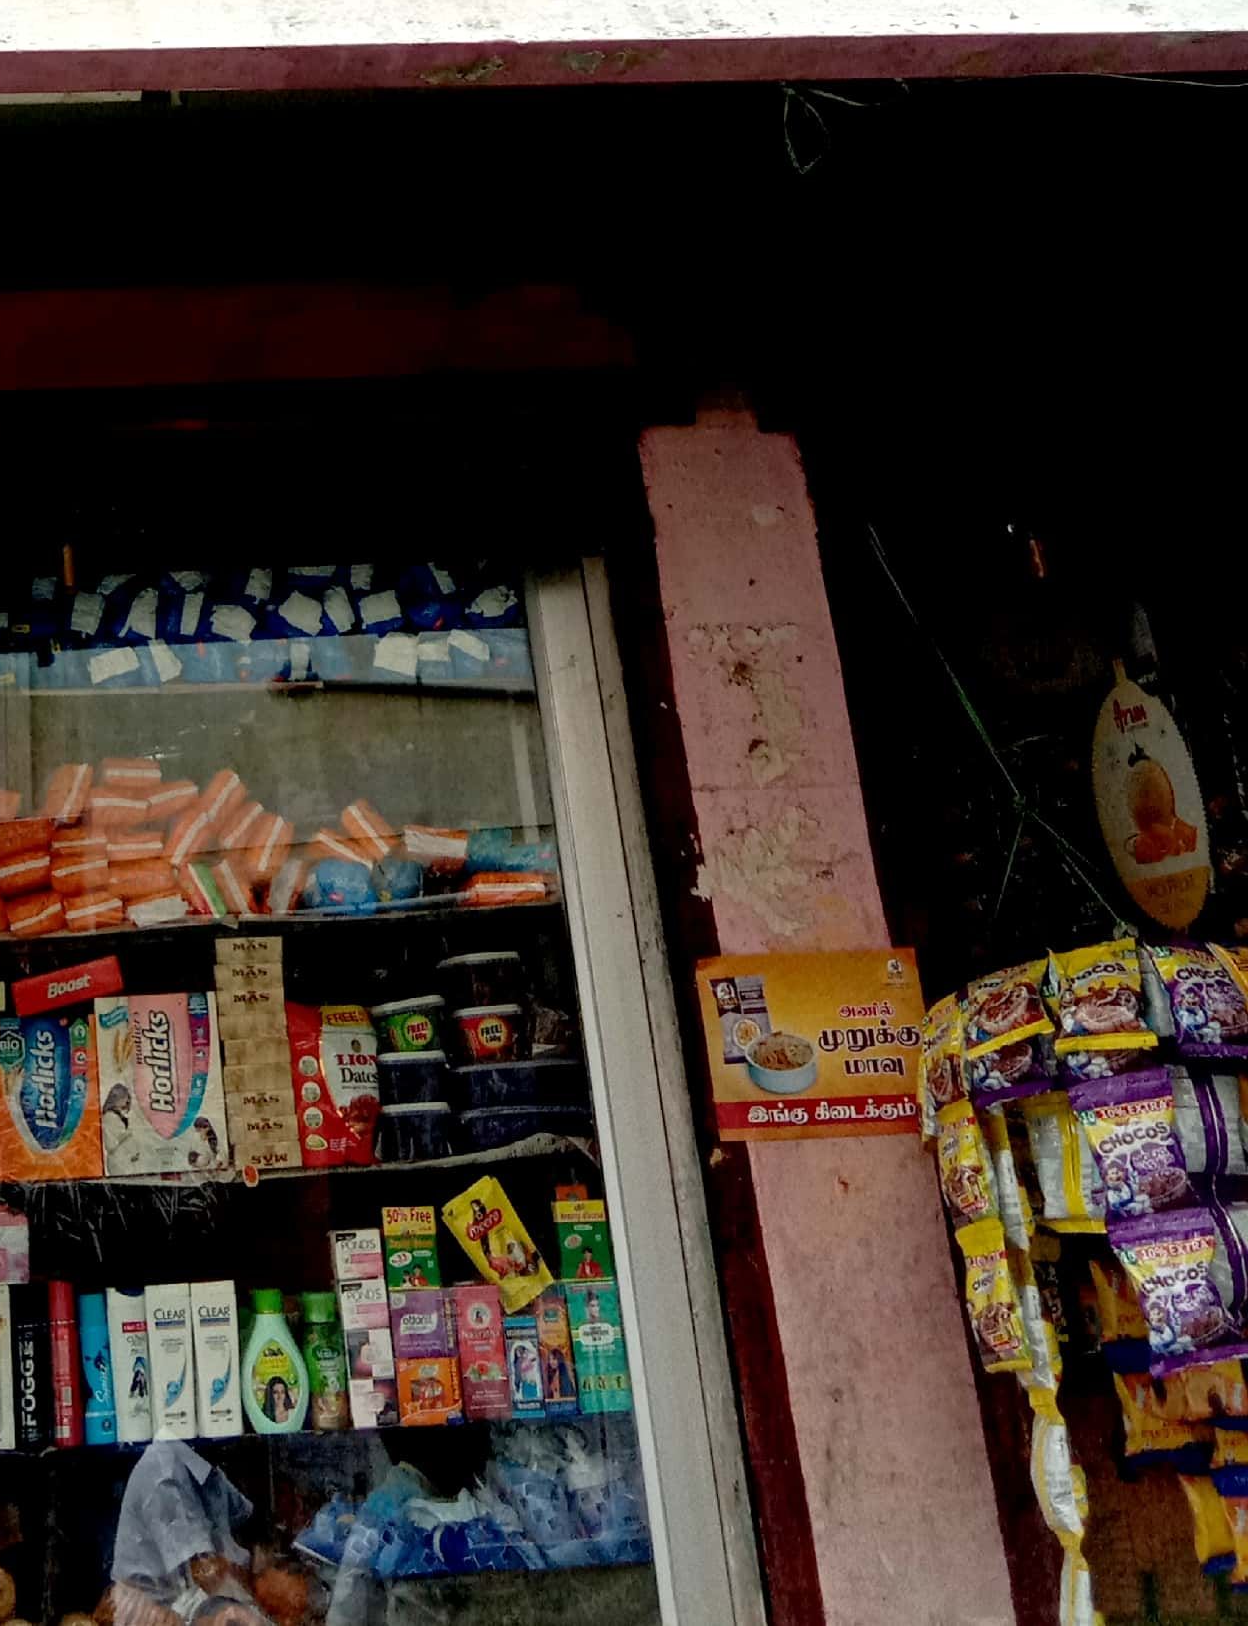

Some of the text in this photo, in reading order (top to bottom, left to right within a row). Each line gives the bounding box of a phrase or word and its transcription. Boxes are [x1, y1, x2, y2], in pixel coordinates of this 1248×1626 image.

[47, 974, 91, 998] Boost
[819, 1019, 920, 1052] முறுக்கு
[141, 1010, 175, 1114] Horlicks
[844, 1056, 905, 1076] மாவு
[28, 1029, 57, 1128] Horlicks
[747, 1096, 917, 1124] இங்கு கிடைக்கும்
[1098, 1120, 1170, 1154] CHOCOS
[153, 1308, 186, 1321] CLEAR
[198, 1305, 231, 1318] CLEAR
